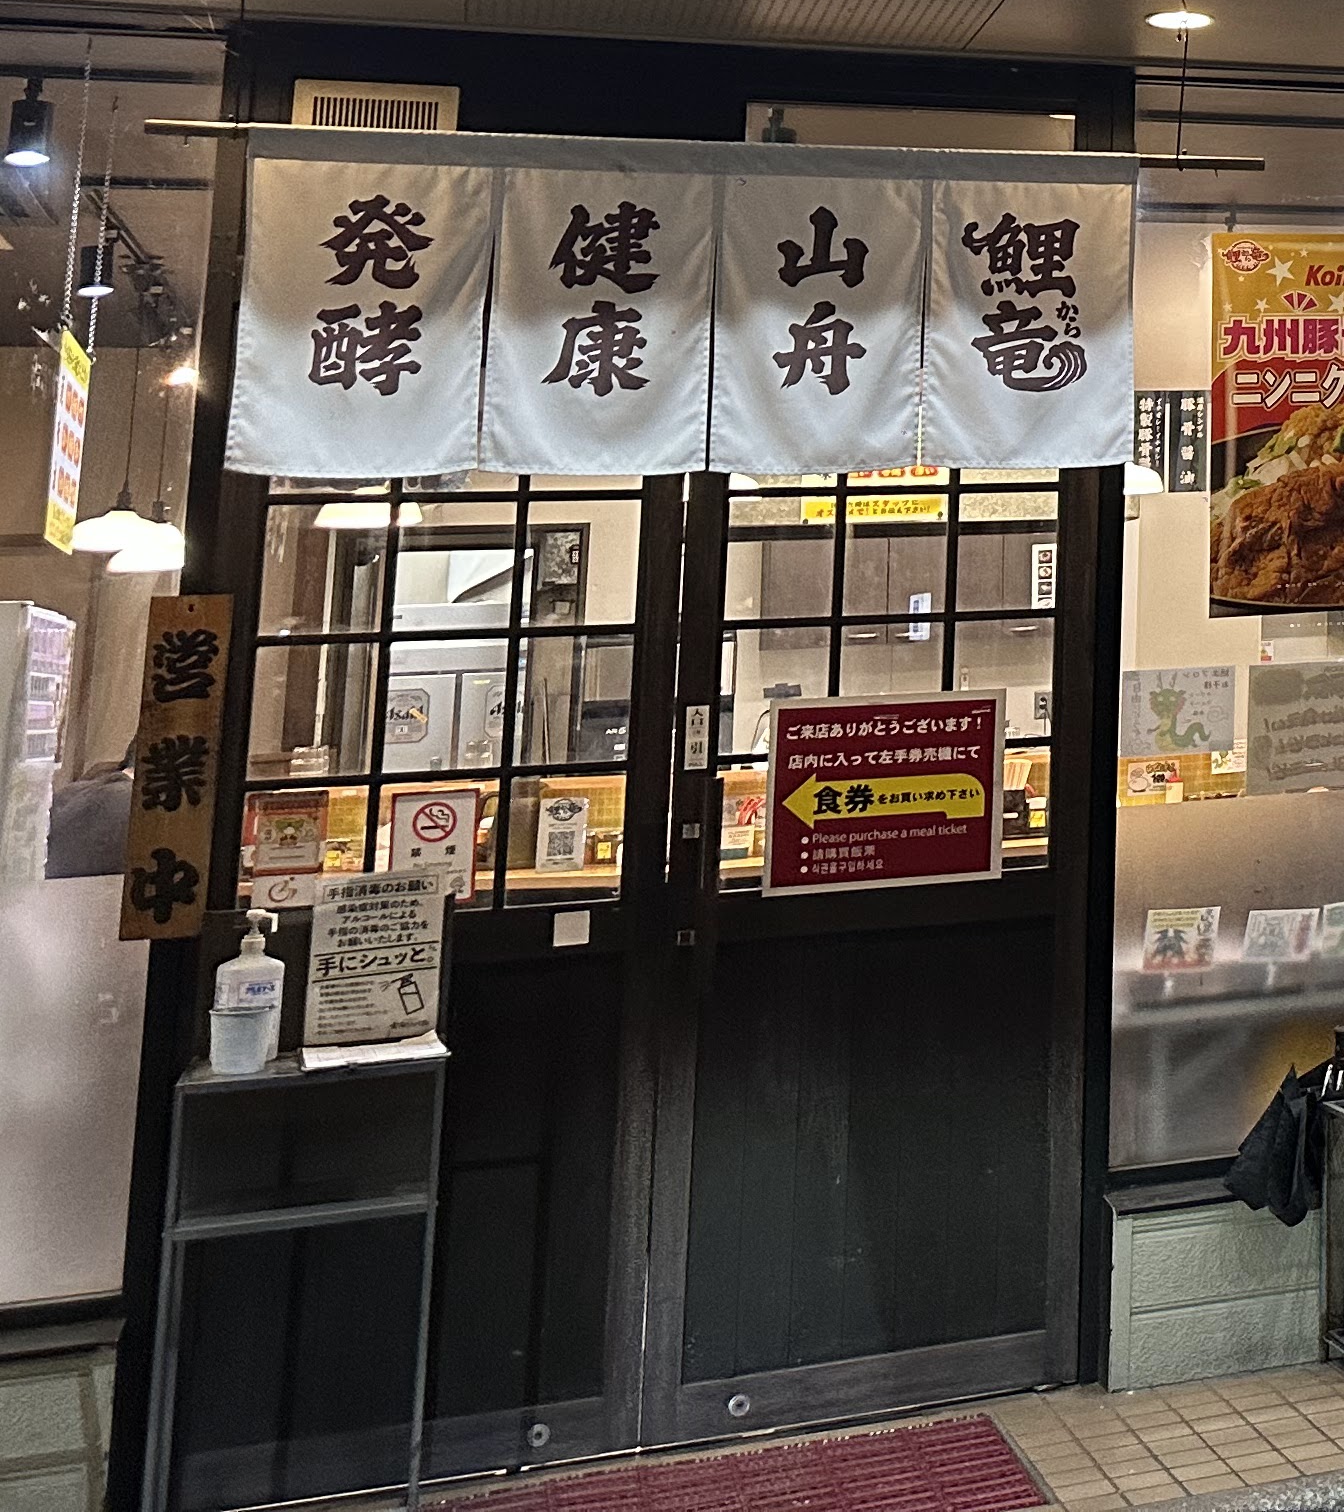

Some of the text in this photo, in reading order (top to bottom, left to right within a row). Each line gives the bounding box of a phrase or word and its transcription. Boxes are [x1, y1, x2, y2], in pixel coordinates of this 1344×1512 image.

[308, 194, 435, 397] 発酵
[541, 200, 661, 398] 健康
[772, 206, 869, 396] 山舟
[788, 745, 981, 770] 店内に入って左手券売機にて
[129, 628, 221, 926] 営業中
[813, 784, 875, 816] 食券
[812, 824, 968, 845] Please purchase a meal ticket
[326, 879, 434, 900] 手指消毒のお願い
[342, 910, 417, 924] アルコールによる
